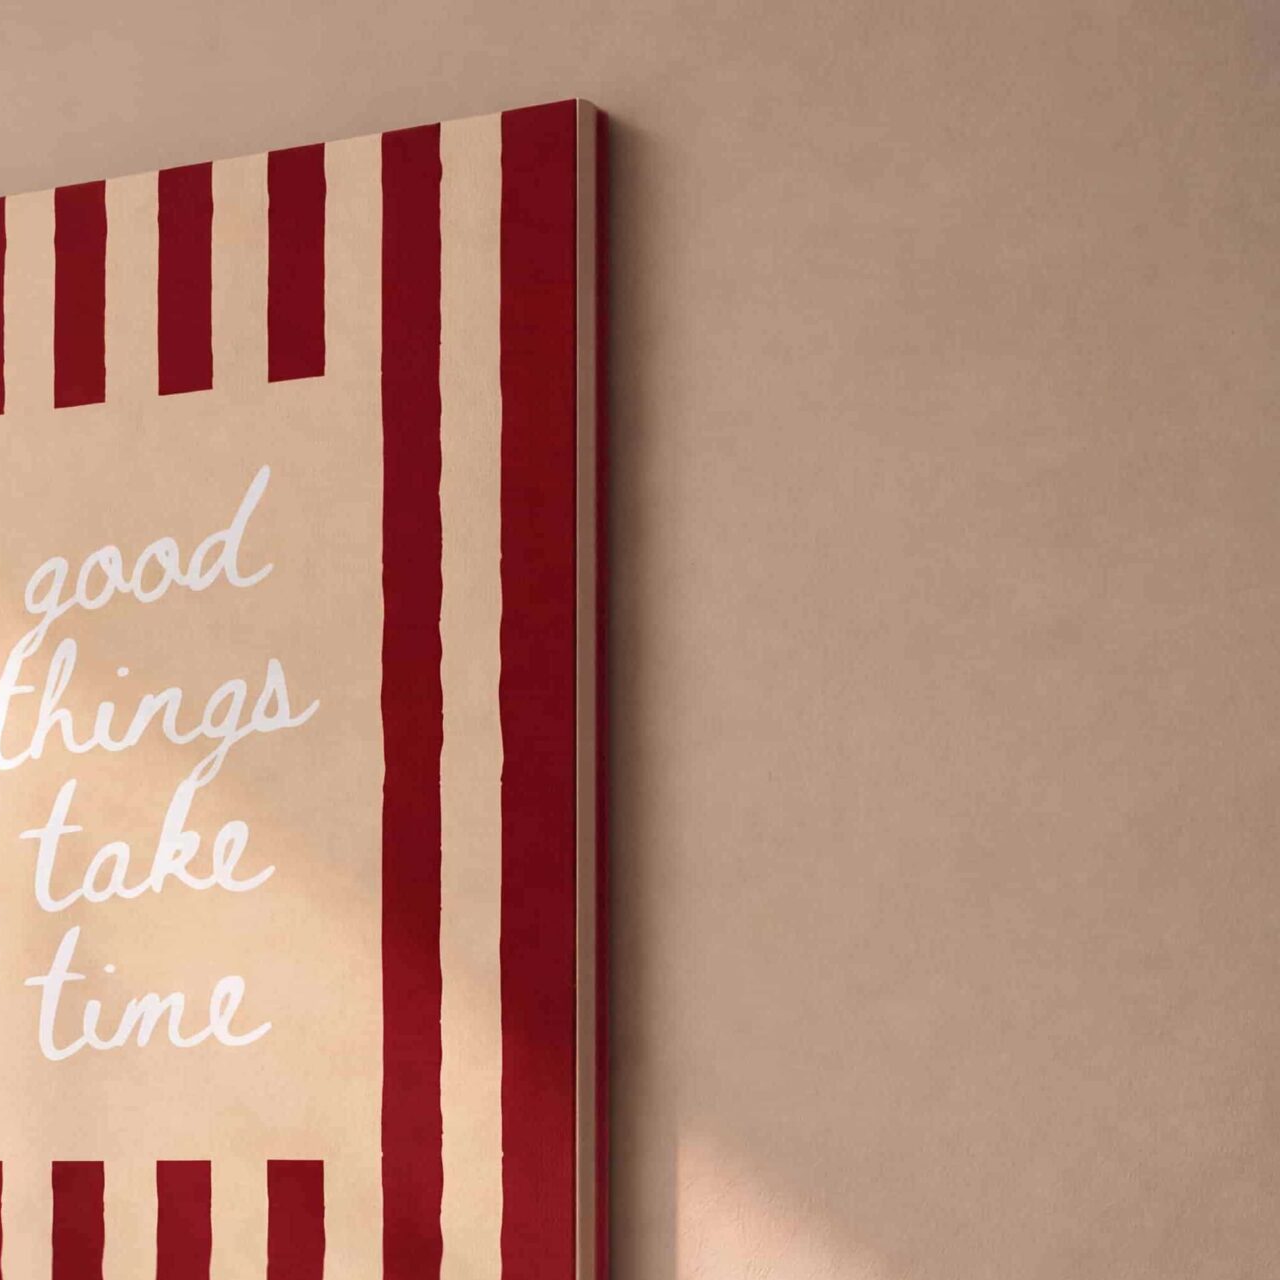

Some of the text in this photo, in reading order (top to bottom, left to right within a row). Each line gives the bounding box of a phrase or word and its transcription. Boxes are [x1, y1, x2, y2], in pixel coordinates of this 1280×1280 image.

[24, 465, 274, 660] good
[20, 778, 276, 912] take
[24, 926, 273, 1061] time
